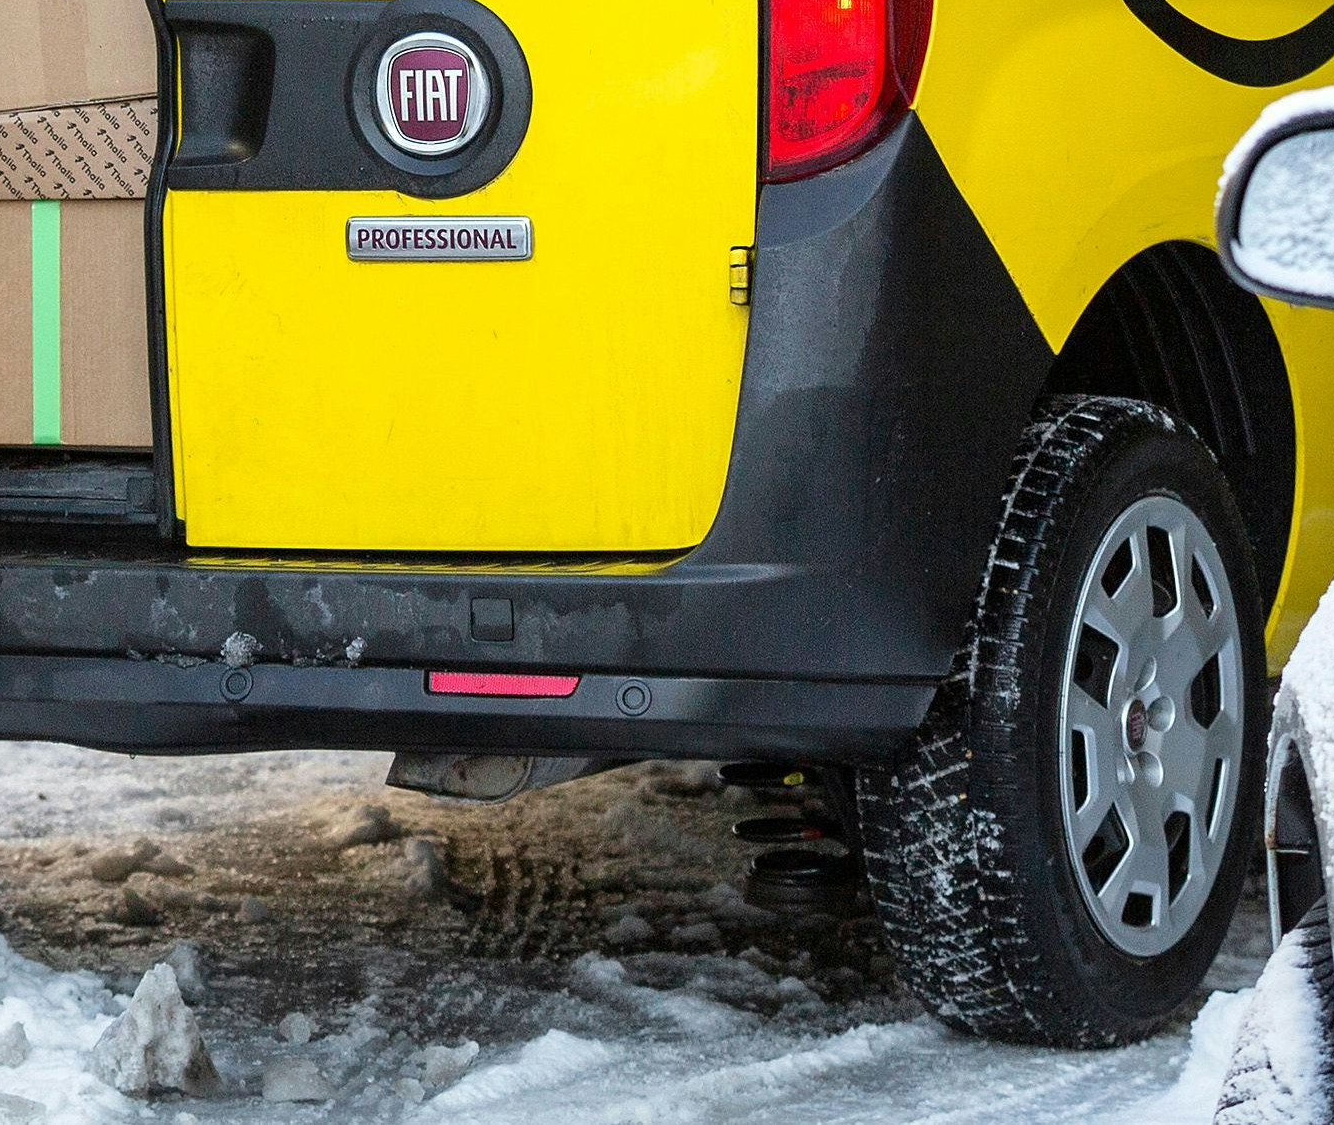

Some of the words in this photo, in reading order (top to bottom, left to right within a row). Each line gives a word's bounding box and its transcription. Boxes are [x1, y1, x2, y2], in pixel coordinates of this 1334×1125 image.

[399, 69, 463, 122] FIAT
[13, 117, 39, 145] Thalia
[126, 108, 151, 137] Thalia
[43, 123, 68, 151] Thalia
[73, 129, 98, 157] Thalia
[103, 135, 128, 163] Thalia
[22, 150, 47, 178] Thalia
[51, 156, 77, 184] Thalia
[81, 162, 106, 190] Thalia
[111, 168, 136, 197] Thalia
[357, 228, 517, 250] PROFESSIONAL
